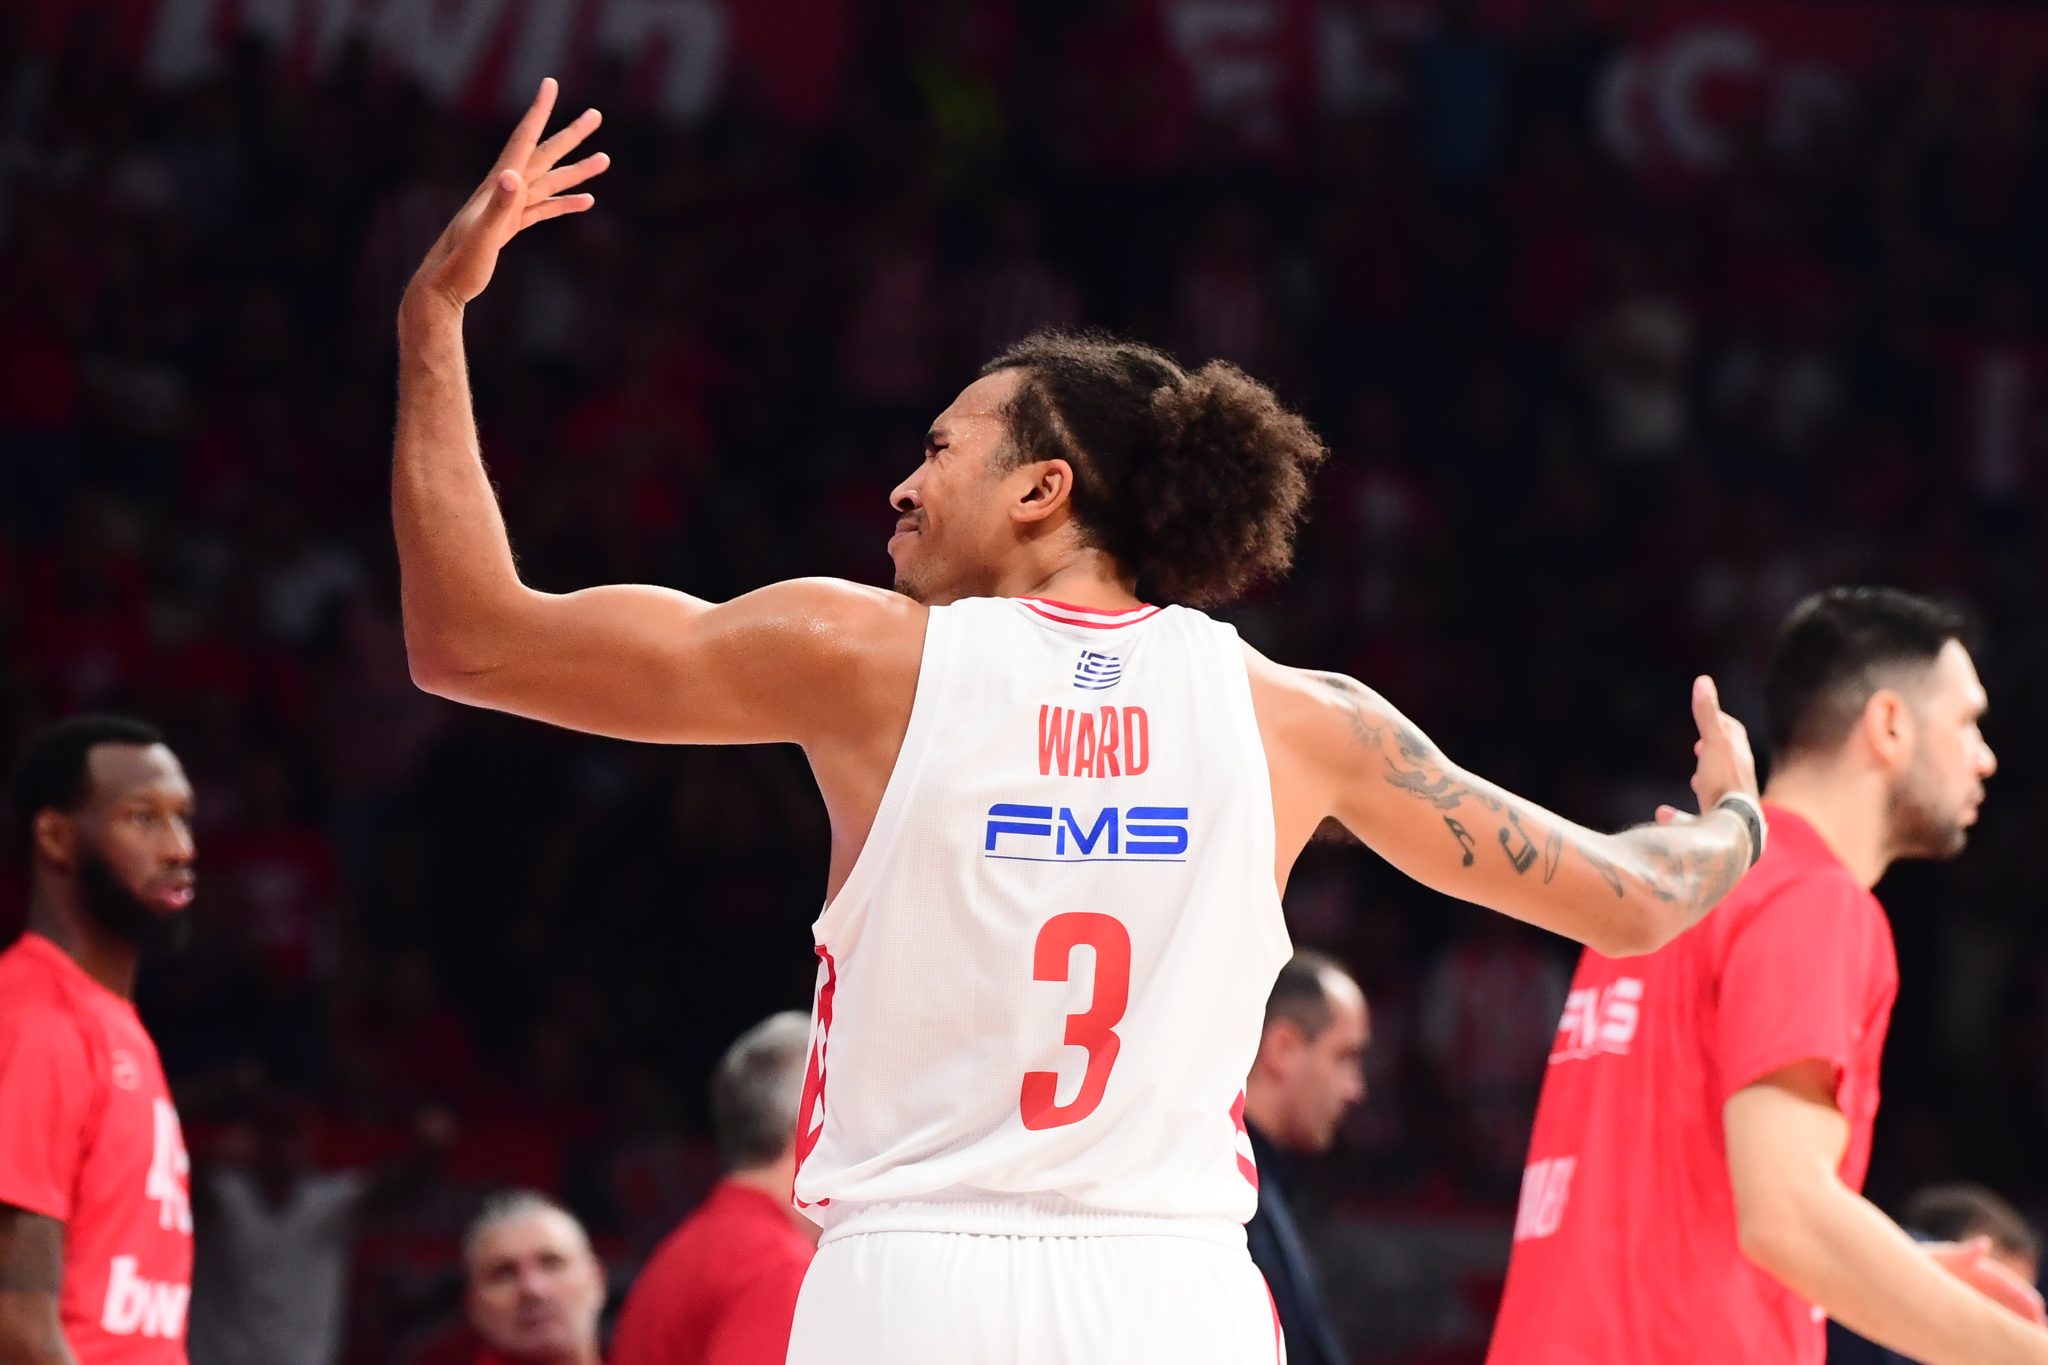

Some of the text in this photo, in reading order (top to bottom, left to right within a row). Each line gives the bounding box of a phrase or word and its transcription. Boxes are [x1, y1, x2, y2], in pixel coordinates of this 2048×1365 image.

[1038, 704, 1149, 779] WARD
[984, 803, 1190, 856] FMS
[1019, 911, 1132, 1131] 3
